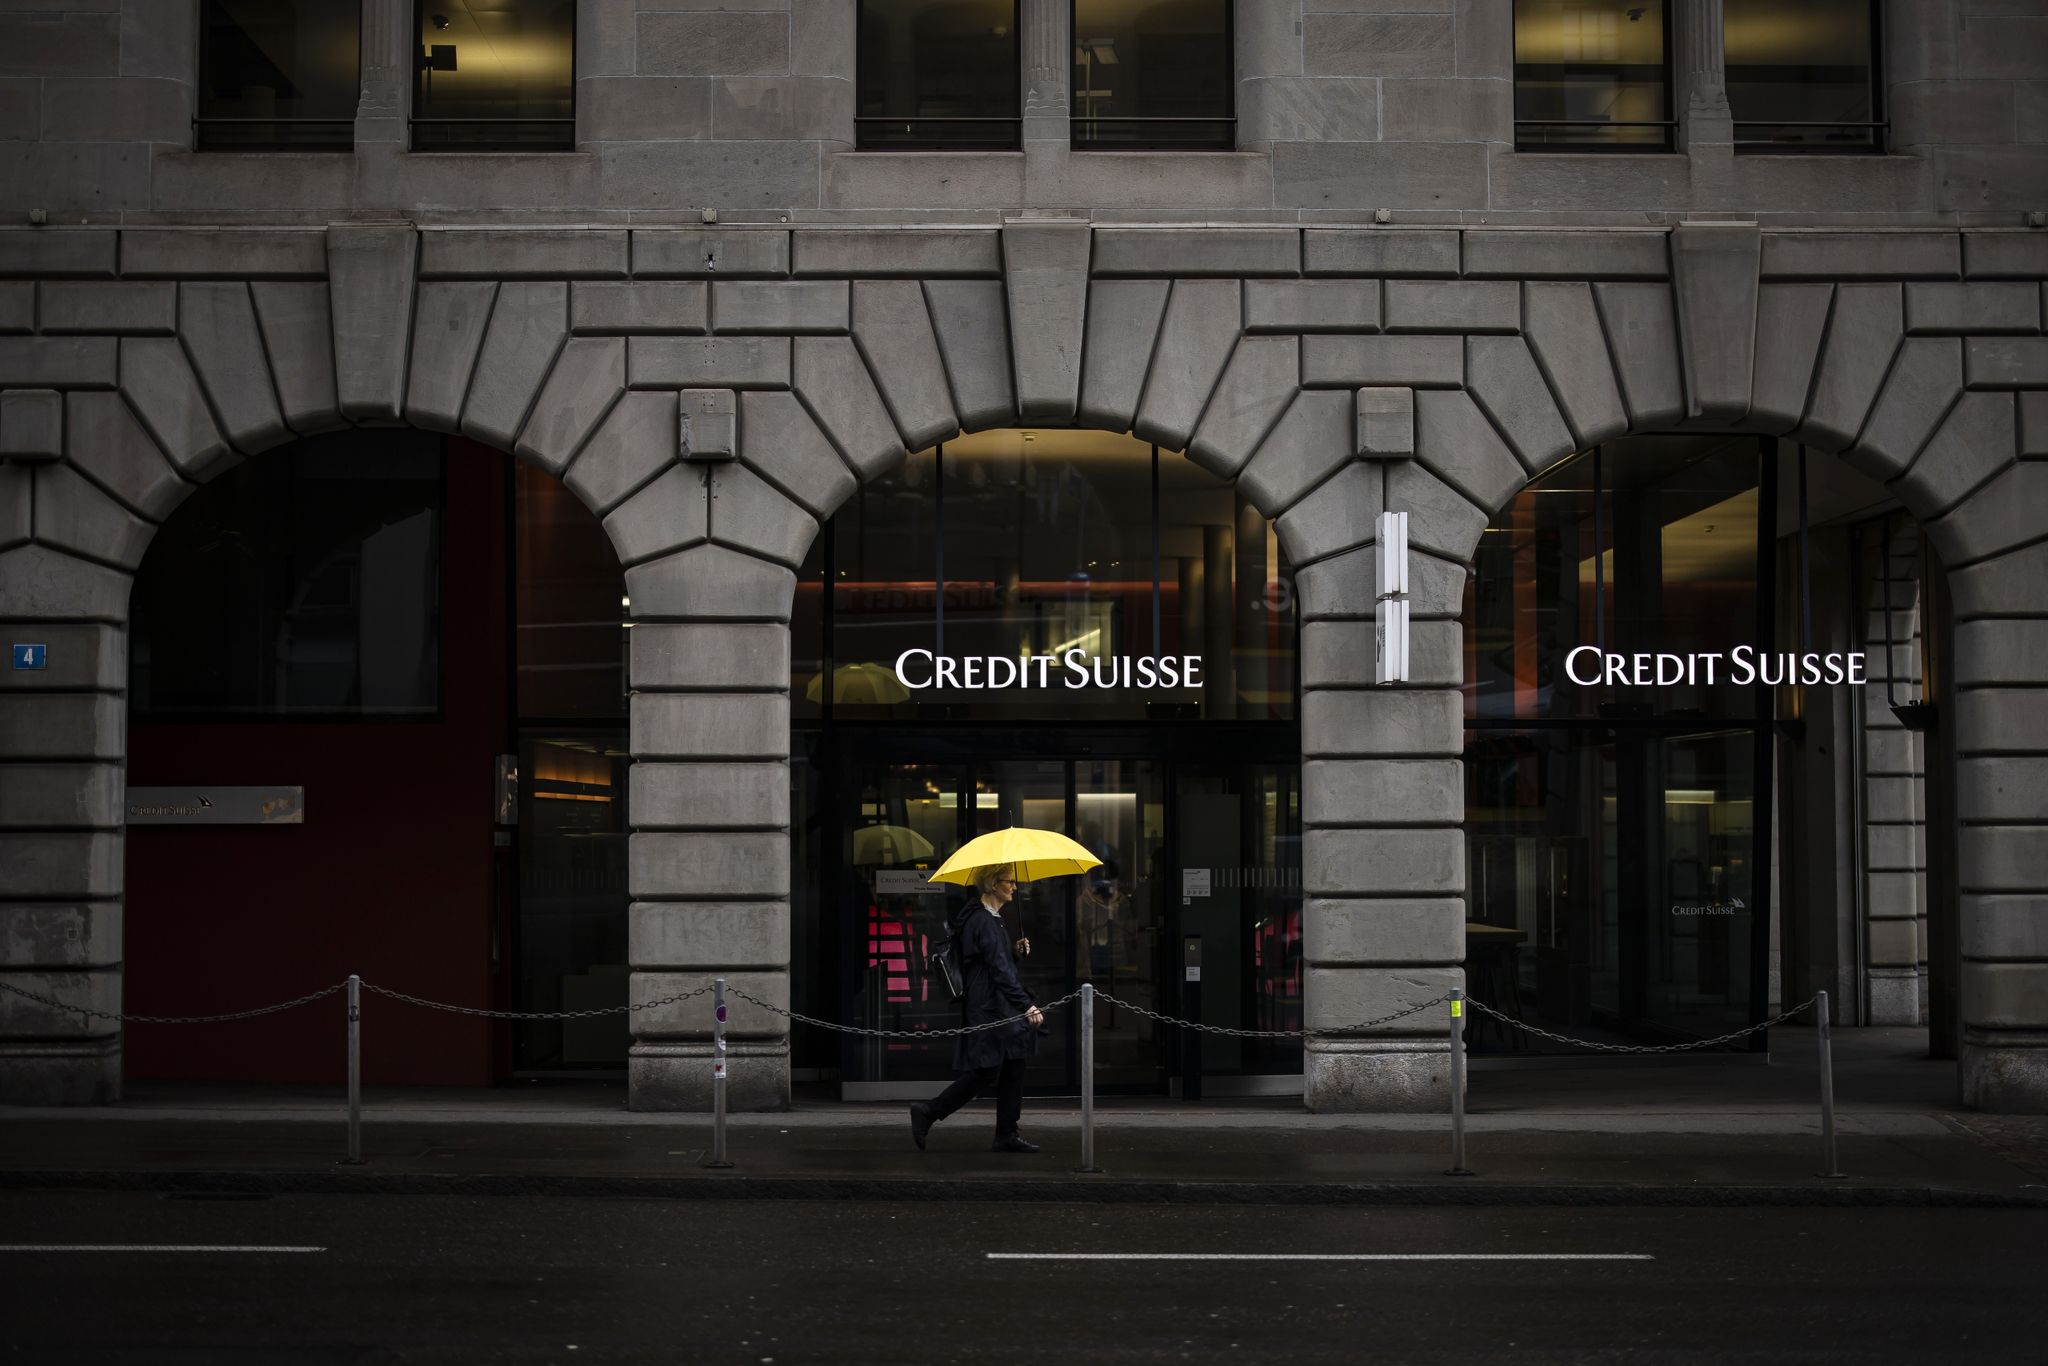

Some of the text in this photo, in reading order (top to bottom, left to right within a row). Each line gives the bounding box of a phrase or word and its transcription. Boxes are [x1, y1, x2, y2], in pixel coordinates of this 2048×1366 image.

[24, 649, 34, 665] 4
[895, 648, 1204, 689] CREDIT SUISSE
[1565, 645, 1867, 686] CREDIT SUISSE
[1672, 905, 1736, 915] CREDIT SUISSE
